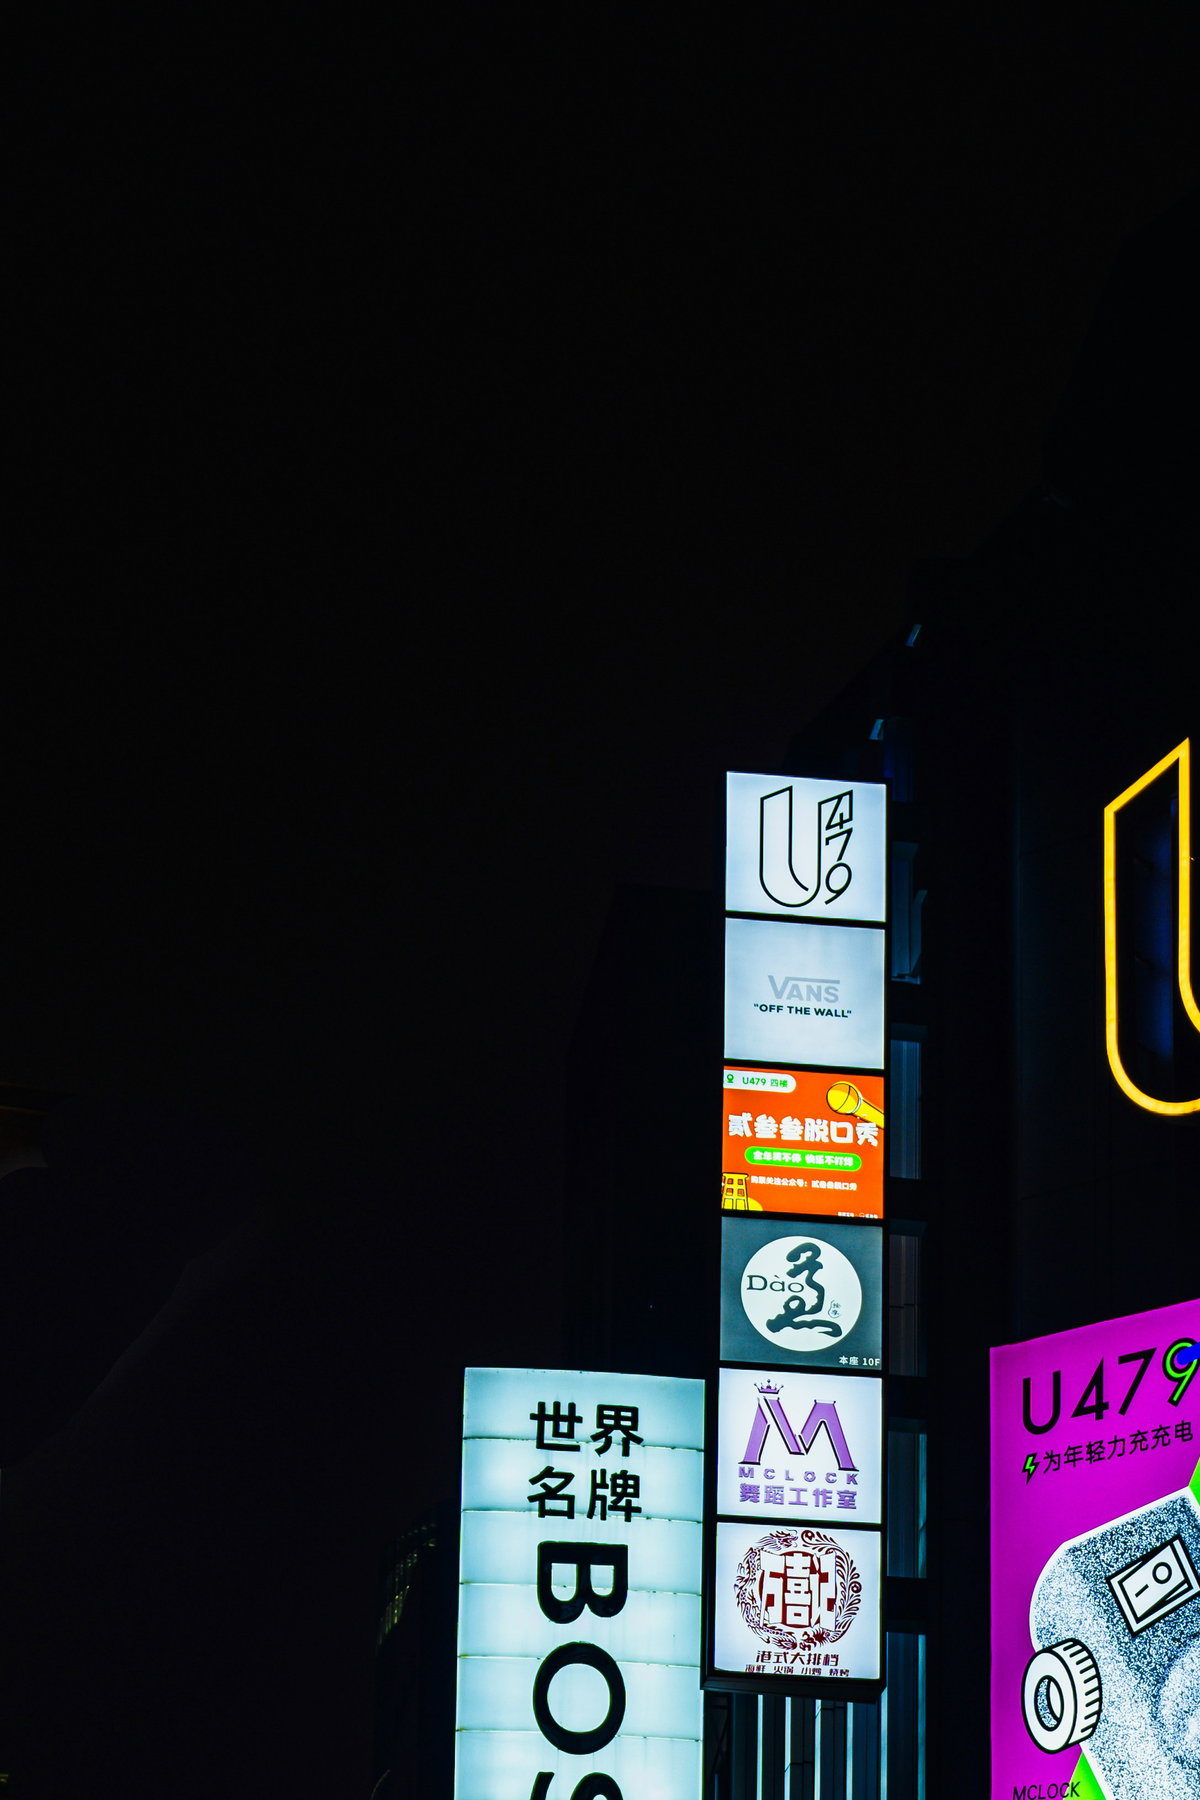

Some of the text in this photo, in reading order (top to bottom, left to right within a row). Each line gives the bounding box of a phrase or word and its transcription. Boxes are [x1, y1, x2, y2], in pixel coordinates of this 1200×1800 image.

[768, 975, 840, 1003] VANS
[753, 1003, 852, 1018] "OFF THE WALL"
[742, 1076, 767, 1086] U479
[728, 1112, 878, 1147] 贰叁叁脱口秀
[839, 1355, 881, 1366] 本座 10F
[529, 1401, 644, 1458] 世界
[1043, 1420, 1194, 1475] 为年轻力充充电
[739, 1466, 858, 1485] MCLOCK
[527, 1465, 643, 1523] 名牌
[739, 1483, 858, 1510] 舞蹈工作室
[755, 1650, 840, 1667] 港式大排档
